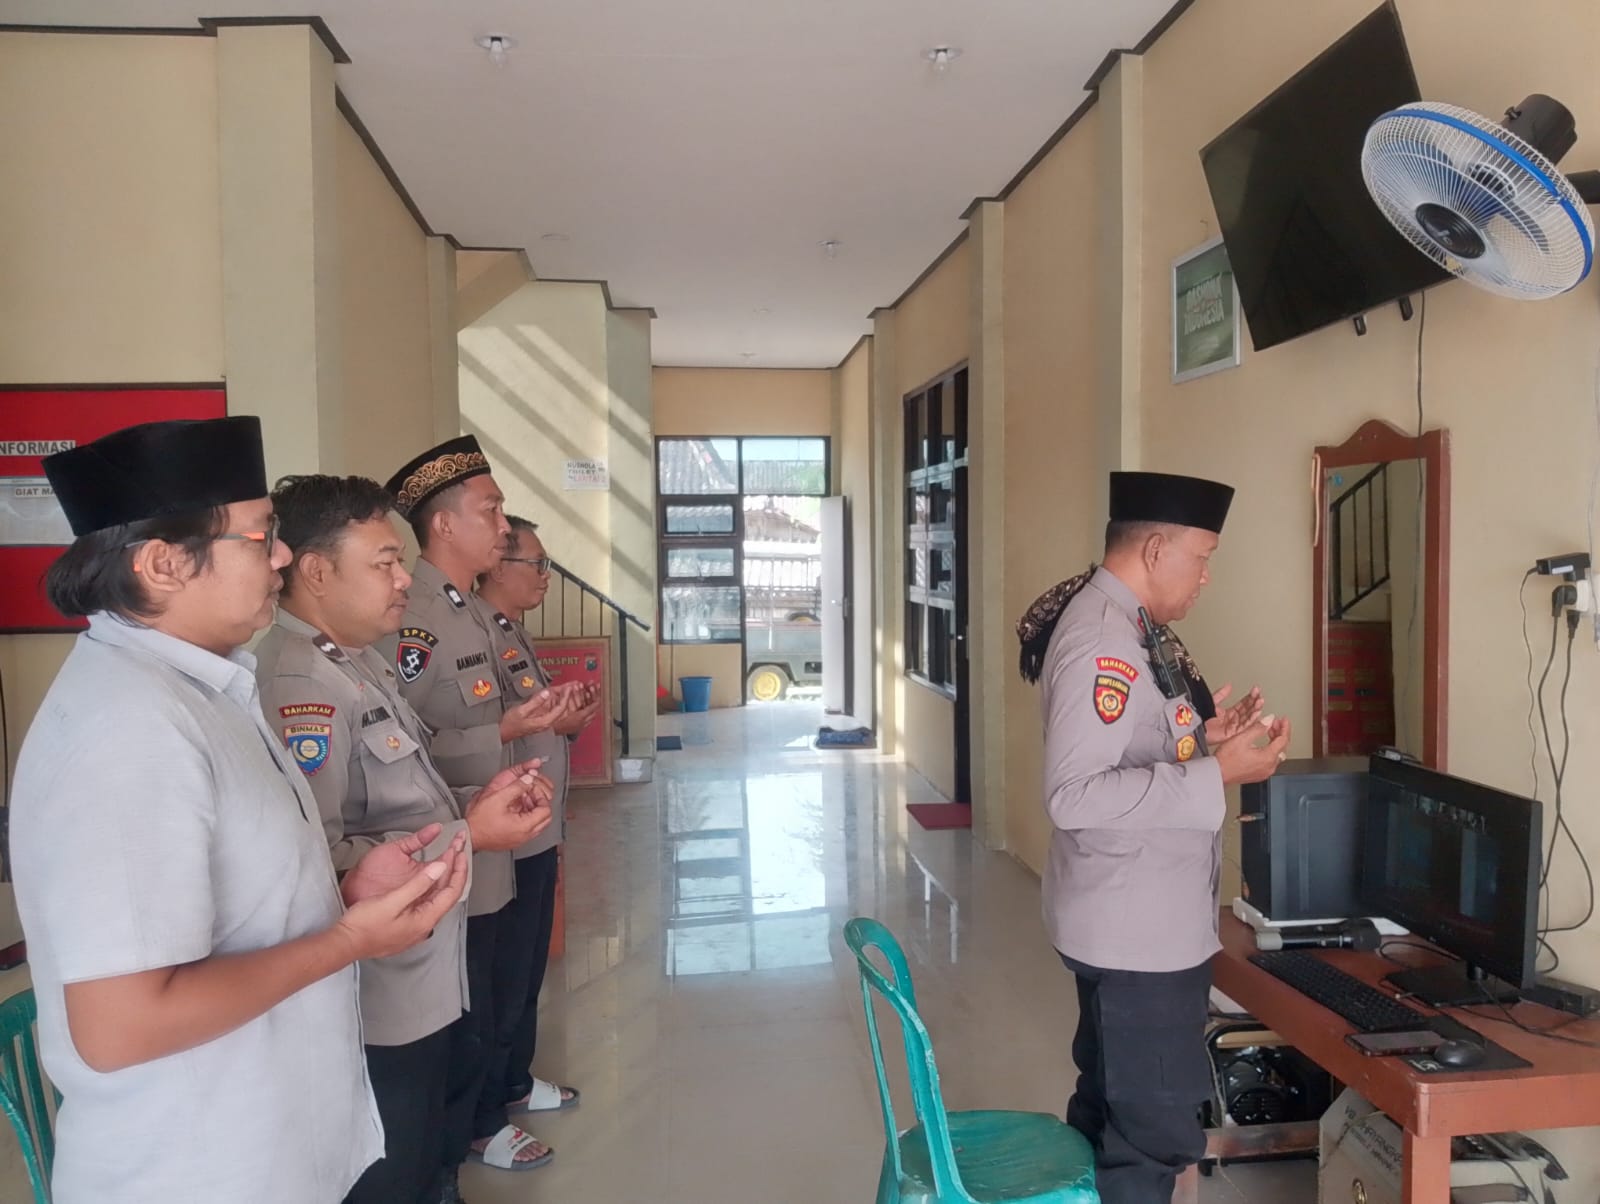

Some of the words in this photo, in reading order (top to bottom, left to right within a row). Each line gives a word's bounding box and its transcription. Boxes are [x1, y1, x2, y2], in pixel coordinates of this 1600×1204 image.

[403, 629, 435, 643] SPKT
[283, 705, 332, 715] BAHARKAM
[290, 725, 325, 733] BINMAS
